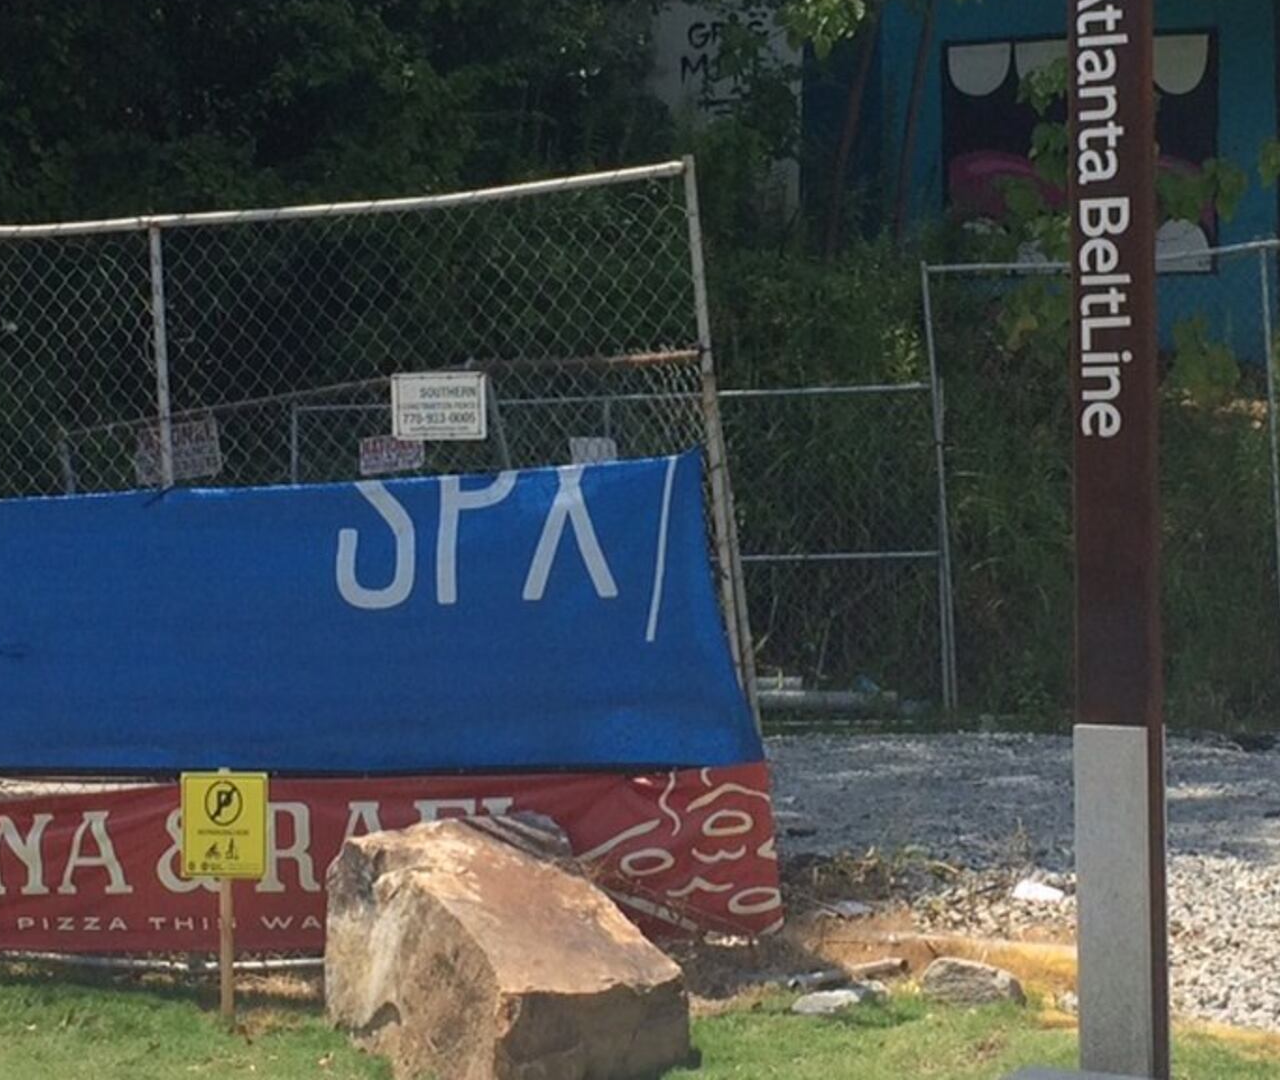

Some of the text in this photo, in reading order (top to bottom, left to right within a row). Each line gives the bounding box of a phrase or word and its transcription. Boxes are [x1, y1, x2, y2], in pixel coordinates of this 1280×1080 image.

[1080, 197, 1131, 437] BeltLine
[420, 386, 476, 399] SOUTHERN
[18, 916, 128, 931] PIZZA
[261, 915, 322, 930] WA
